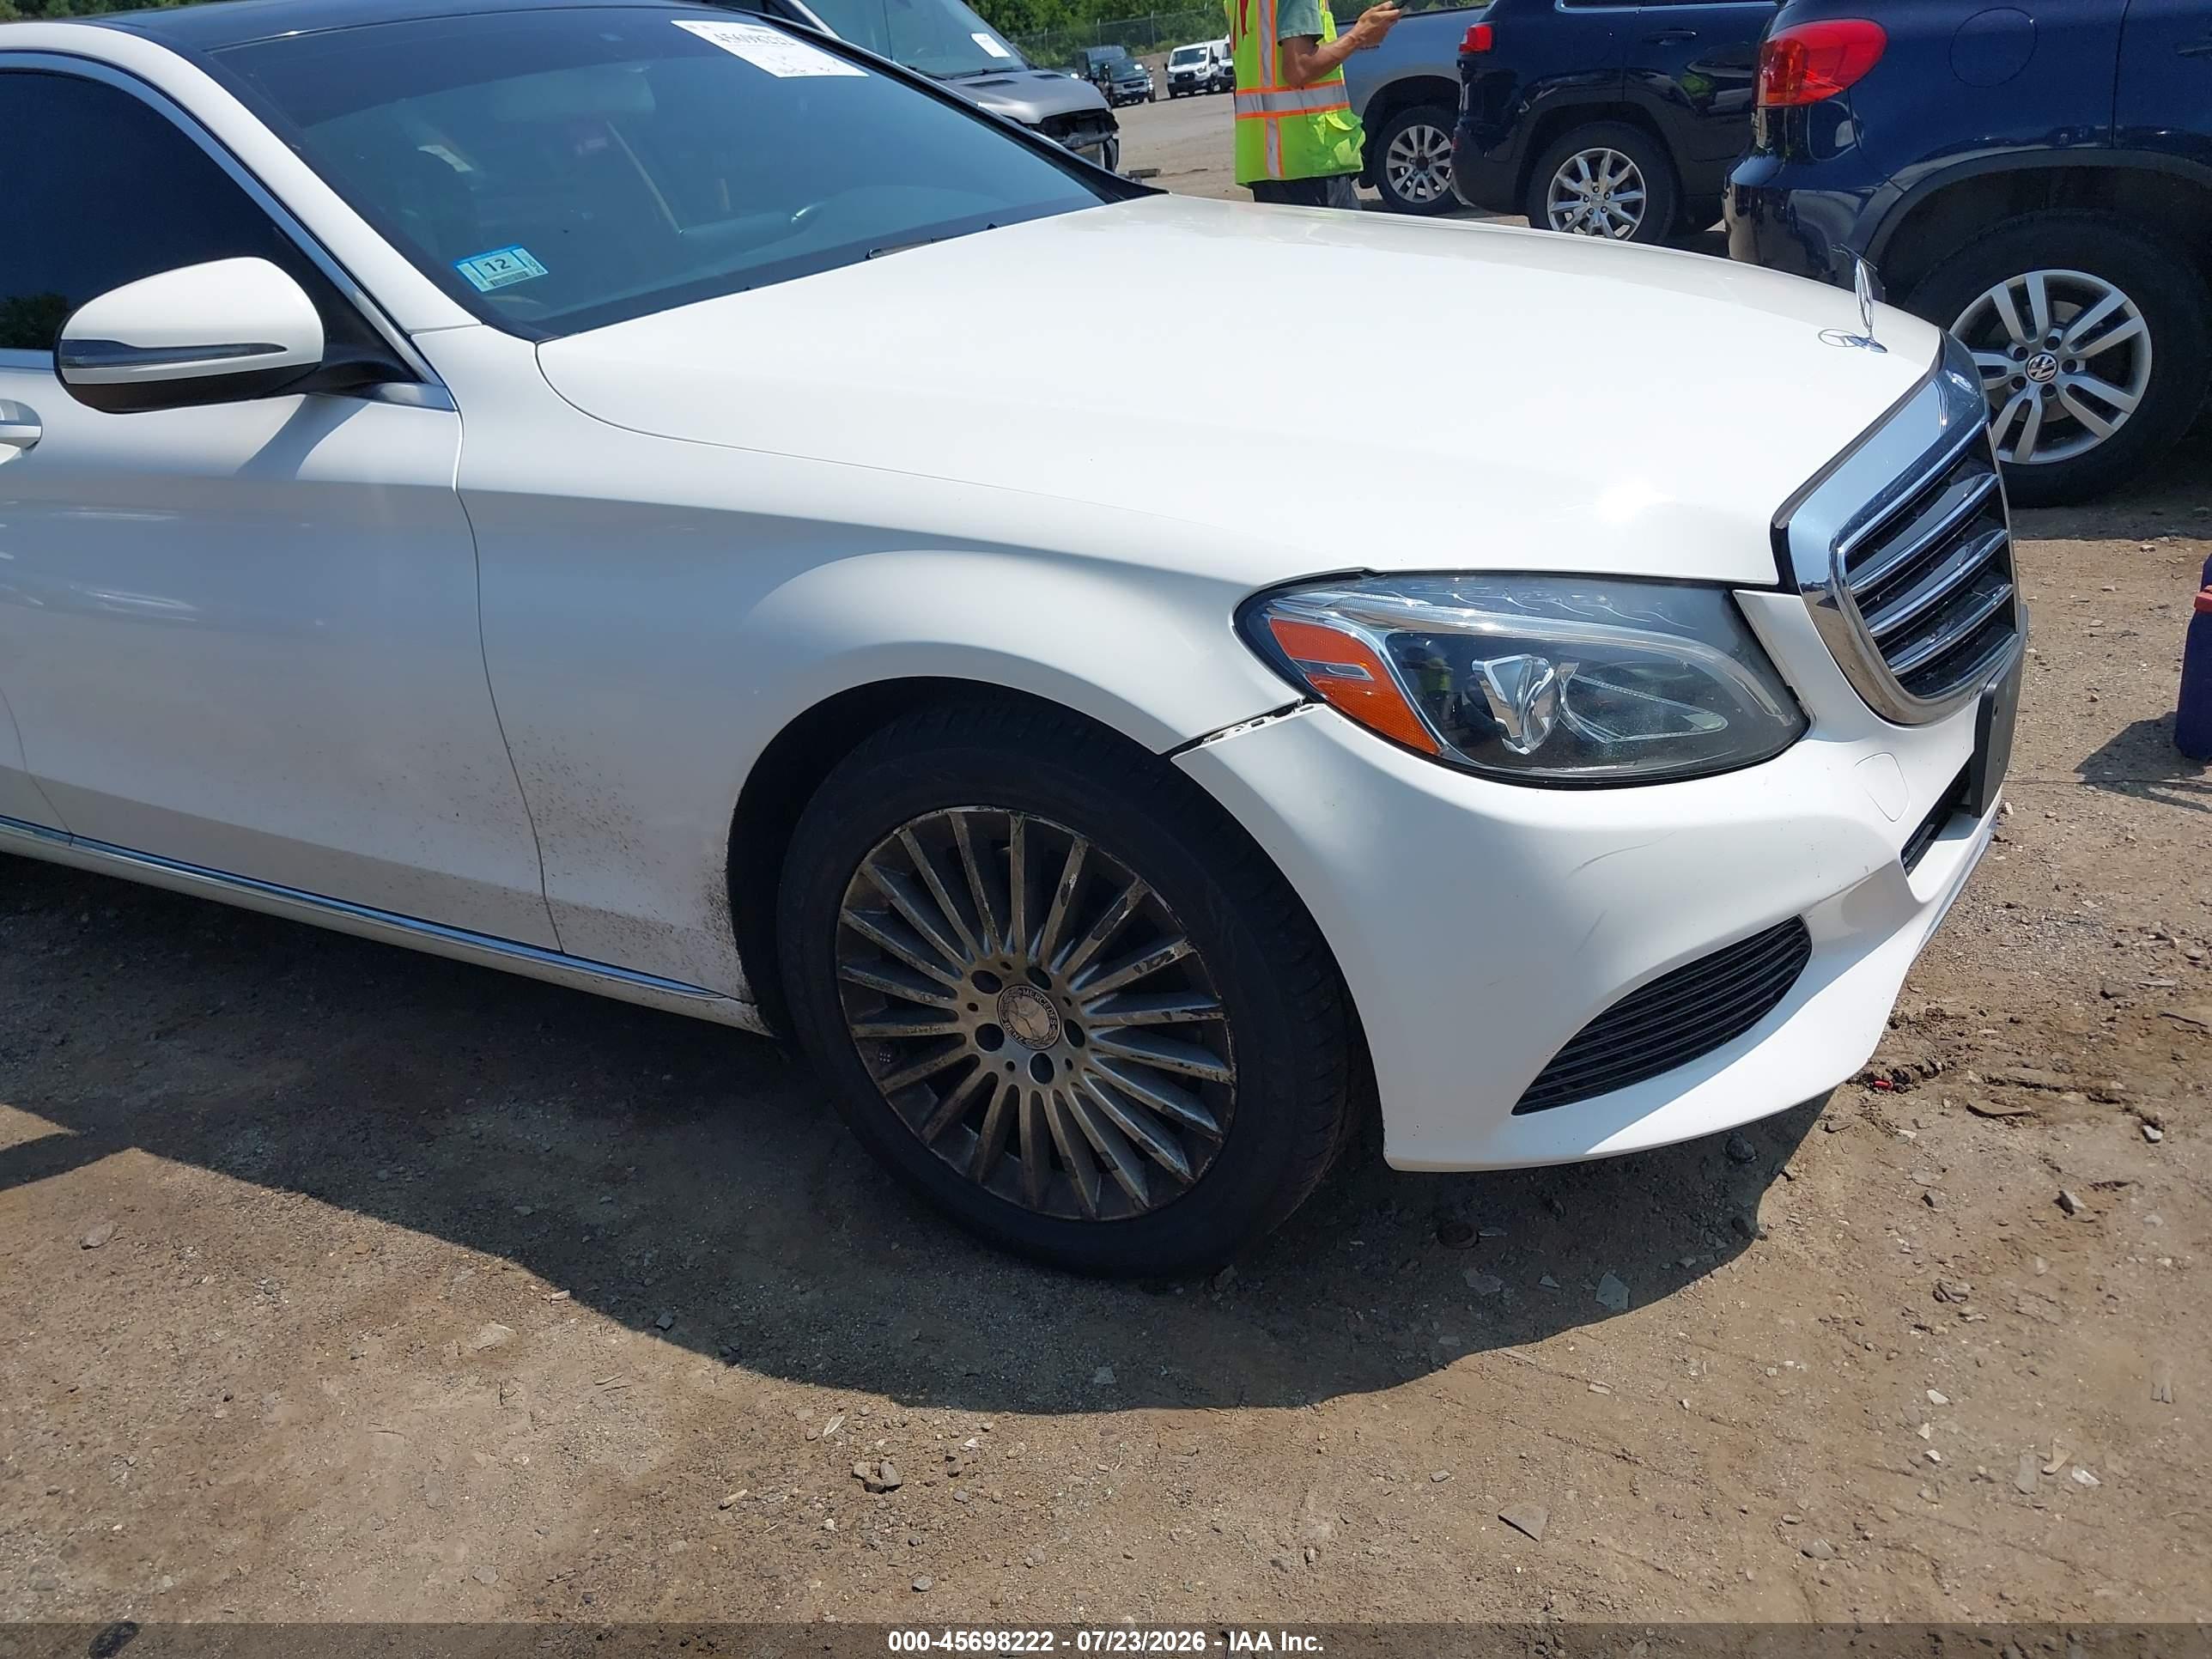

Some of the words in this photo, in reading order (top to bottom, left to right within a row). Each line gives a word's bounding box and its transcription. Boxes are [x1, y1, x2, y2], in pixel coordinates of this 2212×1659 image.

[483, 258, 512, 272] 12
[1022, 988, 1058, 1026] MERCEDES
[1004, 1022, 1025, 1043] BENZ
